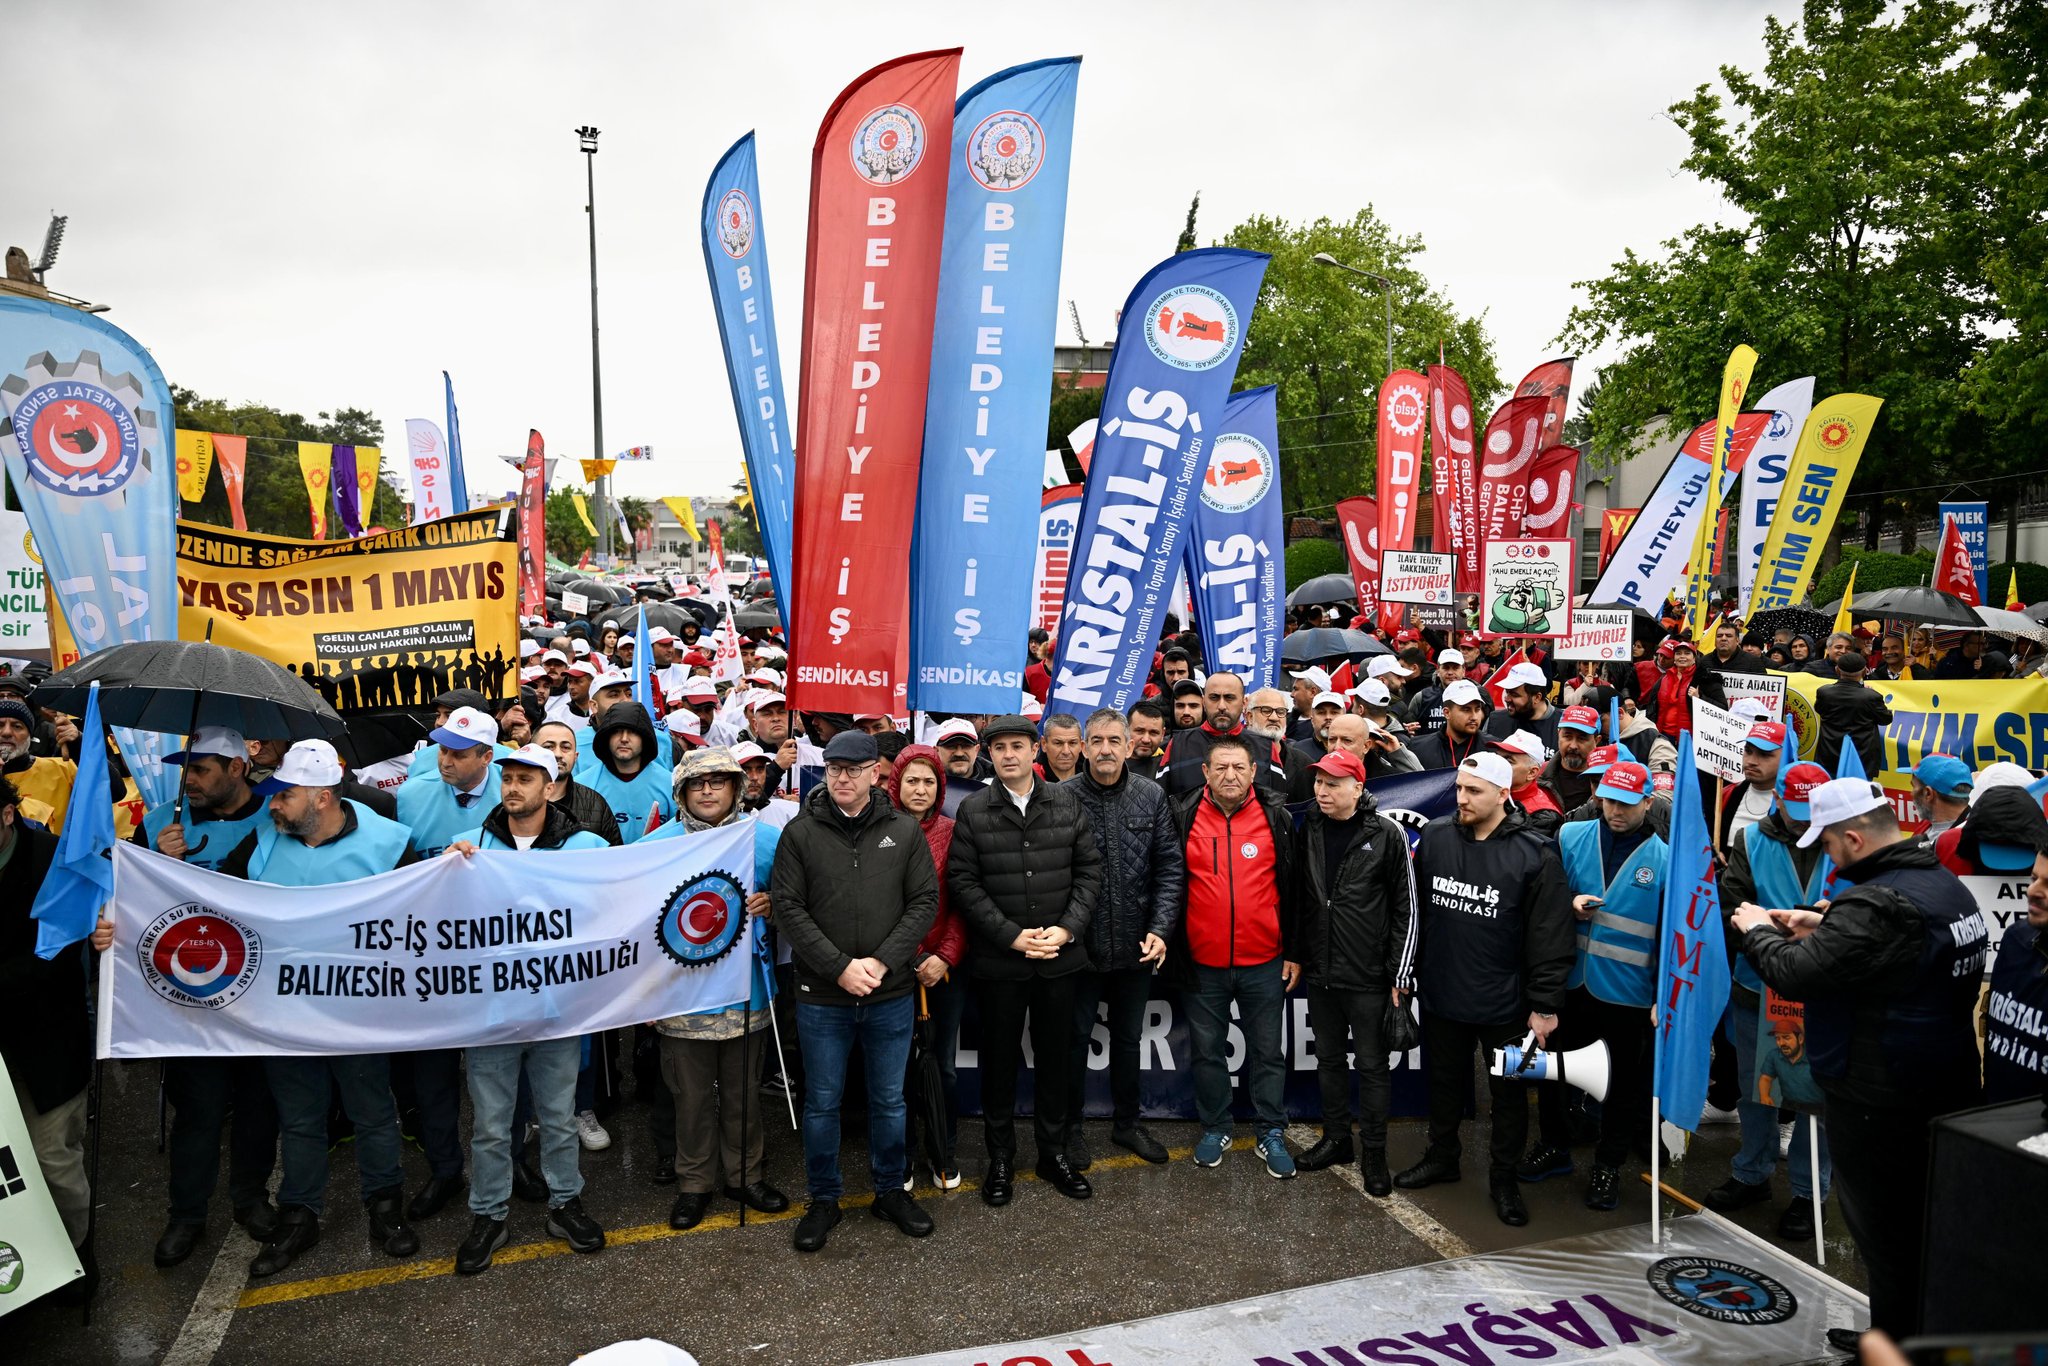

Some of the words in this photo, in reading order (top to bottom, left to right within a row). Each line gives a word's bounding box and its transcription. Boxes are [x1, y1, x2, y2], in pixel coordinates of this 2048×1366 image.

[1174, 287, 1184, 295] VE
[1184, 286, 1215, 299] TOPRAK
[840, 197, 897, 521] BELEDİYE
[962, 202, 1016, 523] BELEDİYE
[1394, 400, 1417, 417] DİSK
[1178, 437, 1204, 486] Sendikası
[1169, 484, 1193, 520] İşçileri
[1509, 484, 1526, 522] CHP
[1792, 463, 1839, 527] SEN
[1162, 519, 1183, 558] Sanayi
[1637, 470, 1712, 580] ALTIEYLÜL
[359, 528, 419, 555] ÇARK
[1053, 386, 1203, 707] KRİSTAL-İŞ
[1144, 556, 1168, 594] Toprak
[1261, 560, 1275, 602] Sendikası
[1385, 573, 1451, 593] İSTİYORUZ
[1510, 566, 1532, 575] EMEKLİ
[1532, 568, 1542, 577] AÇ
[177, 575, 354, 622] YAŞASIN
[363, 573, 384, 611] 1
[393, 560, 505, 609] MAYIS
[828, 556, 851, 645] İŞ
[953, 557, 982, 646] İŞ
[1146, 591, 1158, 606] ve
[1134, 606, 1154, 645] Seramik
[1261, 602, 1278, 632] İşçileri
[1596, 613, 1629, 626] ADALET
[317, 641, 378, 654] YOKSULUN
[379, 636, 427, 650] HAKKINI
[322, 631, 356, 643] GELİN
[358, 628, 401, 642] CANLAR
[402, 625, 421, 637] BİR
[422, 623, 463, 635] OLALIM
[1262, 633, 1278, 659] Sanayi
[796, 662, 889, 688] SENDİKASI
[920, 662, 1023, 690] SENDİKASI
[1115, 645, 1146, 686] Çimento,
[1108, 682, 1131, 711] Cam,
[1746, 678, 1783, 693] ADALET
[1719, 726, 1729, 737] VE
[1725, 713, 1747, 731] ÜCRET
[1700, 730, 1716, 744] TÜM
[1715, 735, 1744, 757] ÜCRETLE
[1432, 875, 1500, 908] KRİSTAL-İŞ
[169, 908, 184, 921] SU
[186, 904, 199, 915] VE
[1431, 893, 1498, 919] SENDİKASI
[189, 938, 215, 948] TES-İŞ
[348, 913, 428, 958] TES-İŞ
[436, 907, 574, 951] SENDİKASI
[683, 939, 727, 958] 1952
[276, 961, 407, 998] BALIKESİR
[414, 963, 484, 1002] ŞUBE
[493, 940, 640, 995] BAŞKANLIĞI
[1702, 1259, 1761, 1280] TÜRKİYE
